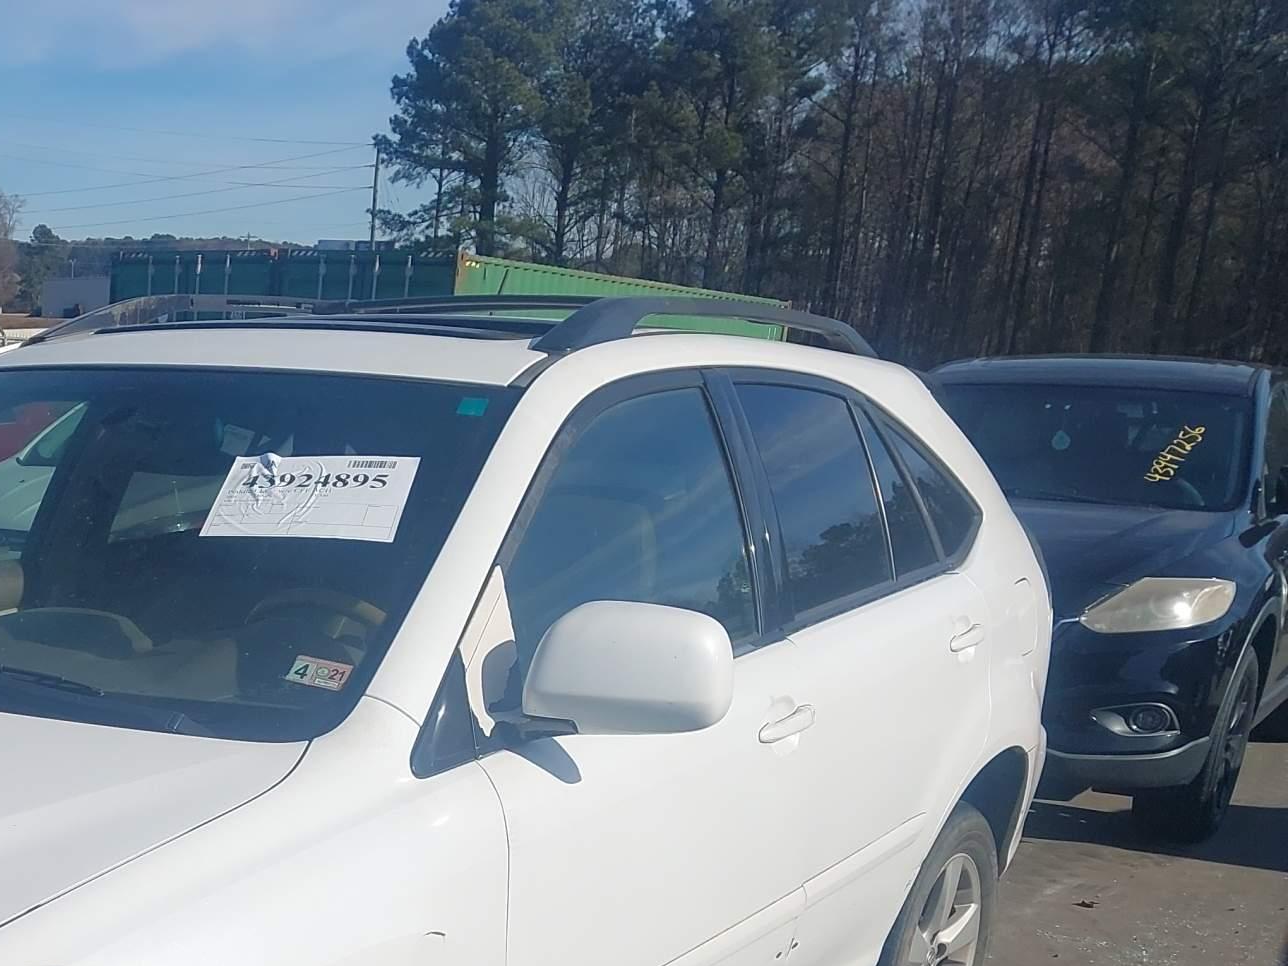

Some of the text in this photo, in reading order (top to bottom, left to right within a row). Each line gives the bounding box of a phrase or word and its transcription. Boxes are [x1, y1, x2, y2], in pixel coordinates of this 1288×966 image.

[241, 472, 390, 489] 43924895
[294, 663, 346, 682] 4 21
